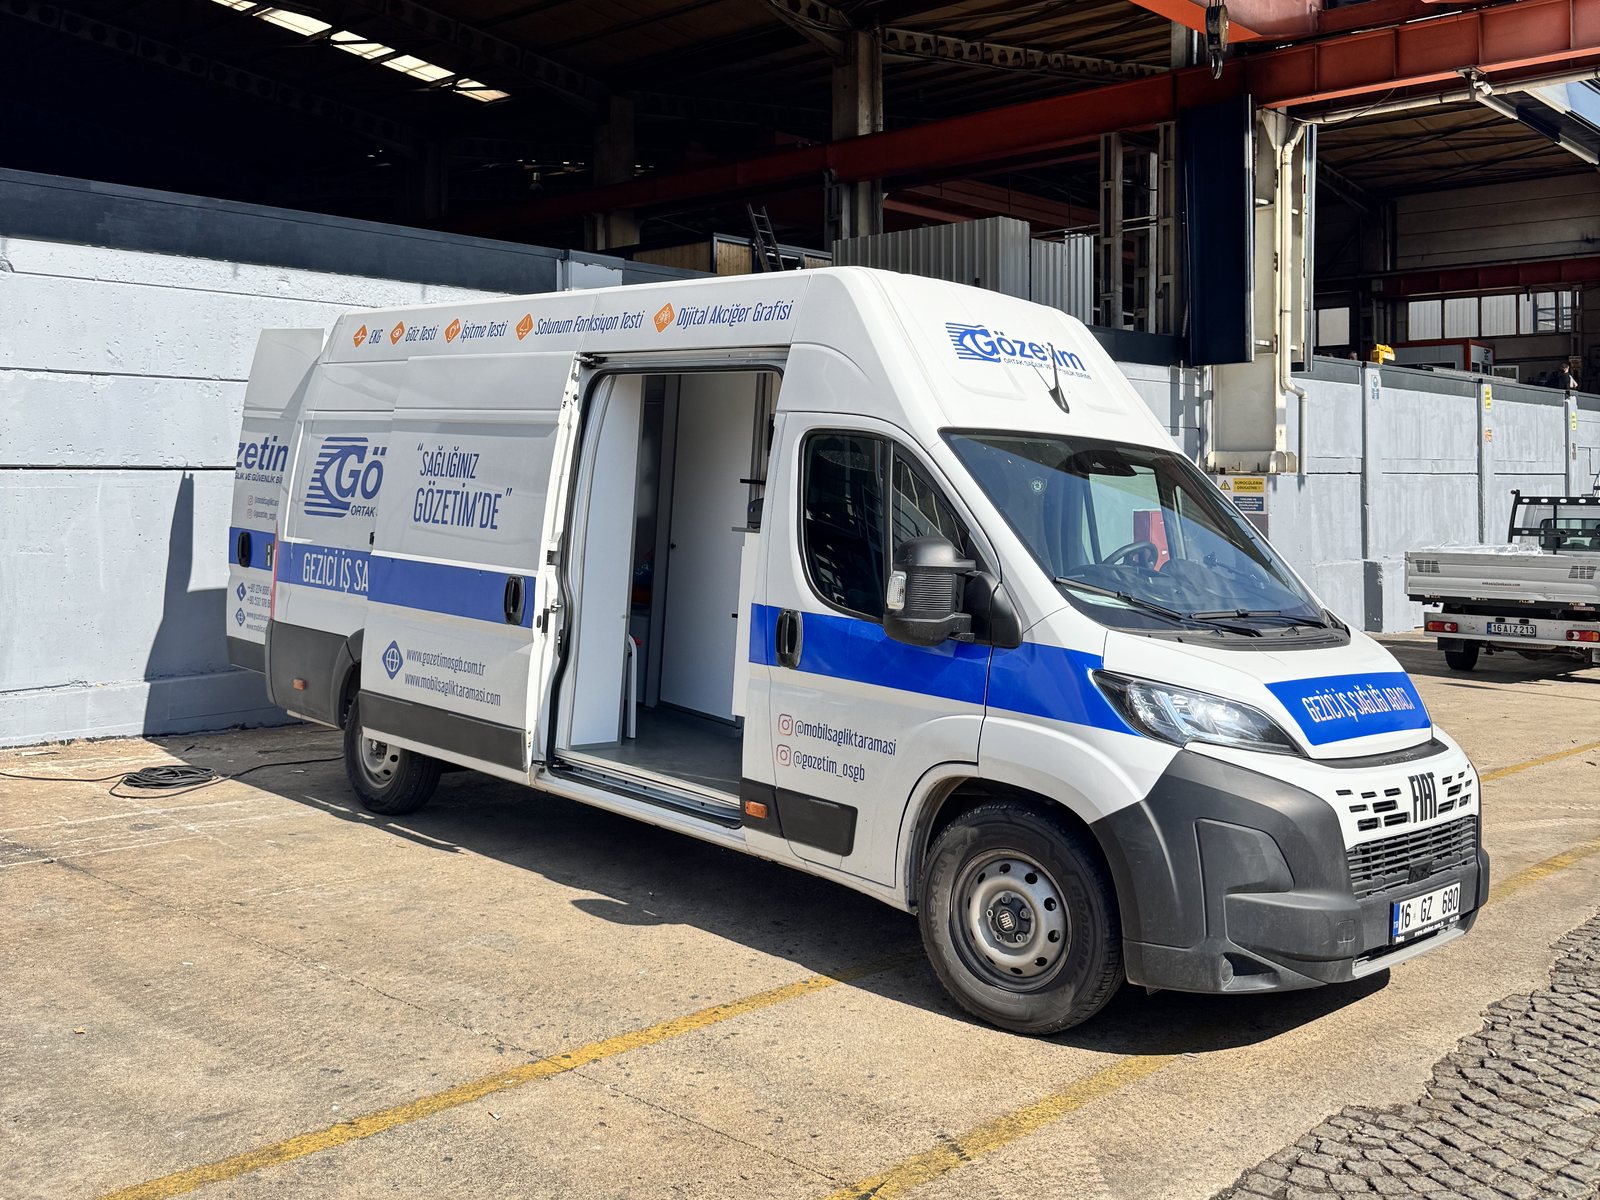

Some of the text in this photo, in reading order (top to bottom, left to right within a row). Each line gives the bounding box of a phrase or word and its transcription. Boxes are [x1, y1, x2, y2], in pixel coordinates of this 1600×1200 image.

[534, 310, 646, 336] Solunum Fonksiyon Testi
[676, 299, 794, 330] Dijital Akciğer Grafisi
[368, 328, 384, 345] EKG
[405, 324, 439, 342] Göz Testi
[460, 320, 509, 343] İşitme Testi
[350, 505, 376, 518] ORTAK
[302, 547, 338, 587] GEZİCİ
[339, 550, 352, 594] İŞ
[1493, 624, 1502, 632] 16
[1519, 625, 1535, 634] 213
[406, 648, 486, 677] www.gozetimosgb.com.tr
[404, 672, 502, 706] www.mobilsagliktaramasi.com
[1301, 683, 1416, 723] GEZİCİ İŞ SAĞLIĞI ARACI
[795, 719, 897, 757] @mobilsagliktaramasi
[793, 750, 866, 783] @gozetim_osgb
[1407, 771, 1438, 824] FIAT
[999, 912, 1014, 929] FIAT
[1400, 902, 1412, 931] 16
[1420, 895, 1434, 924] GZ
[1441, 886, 1460, 915] 680
